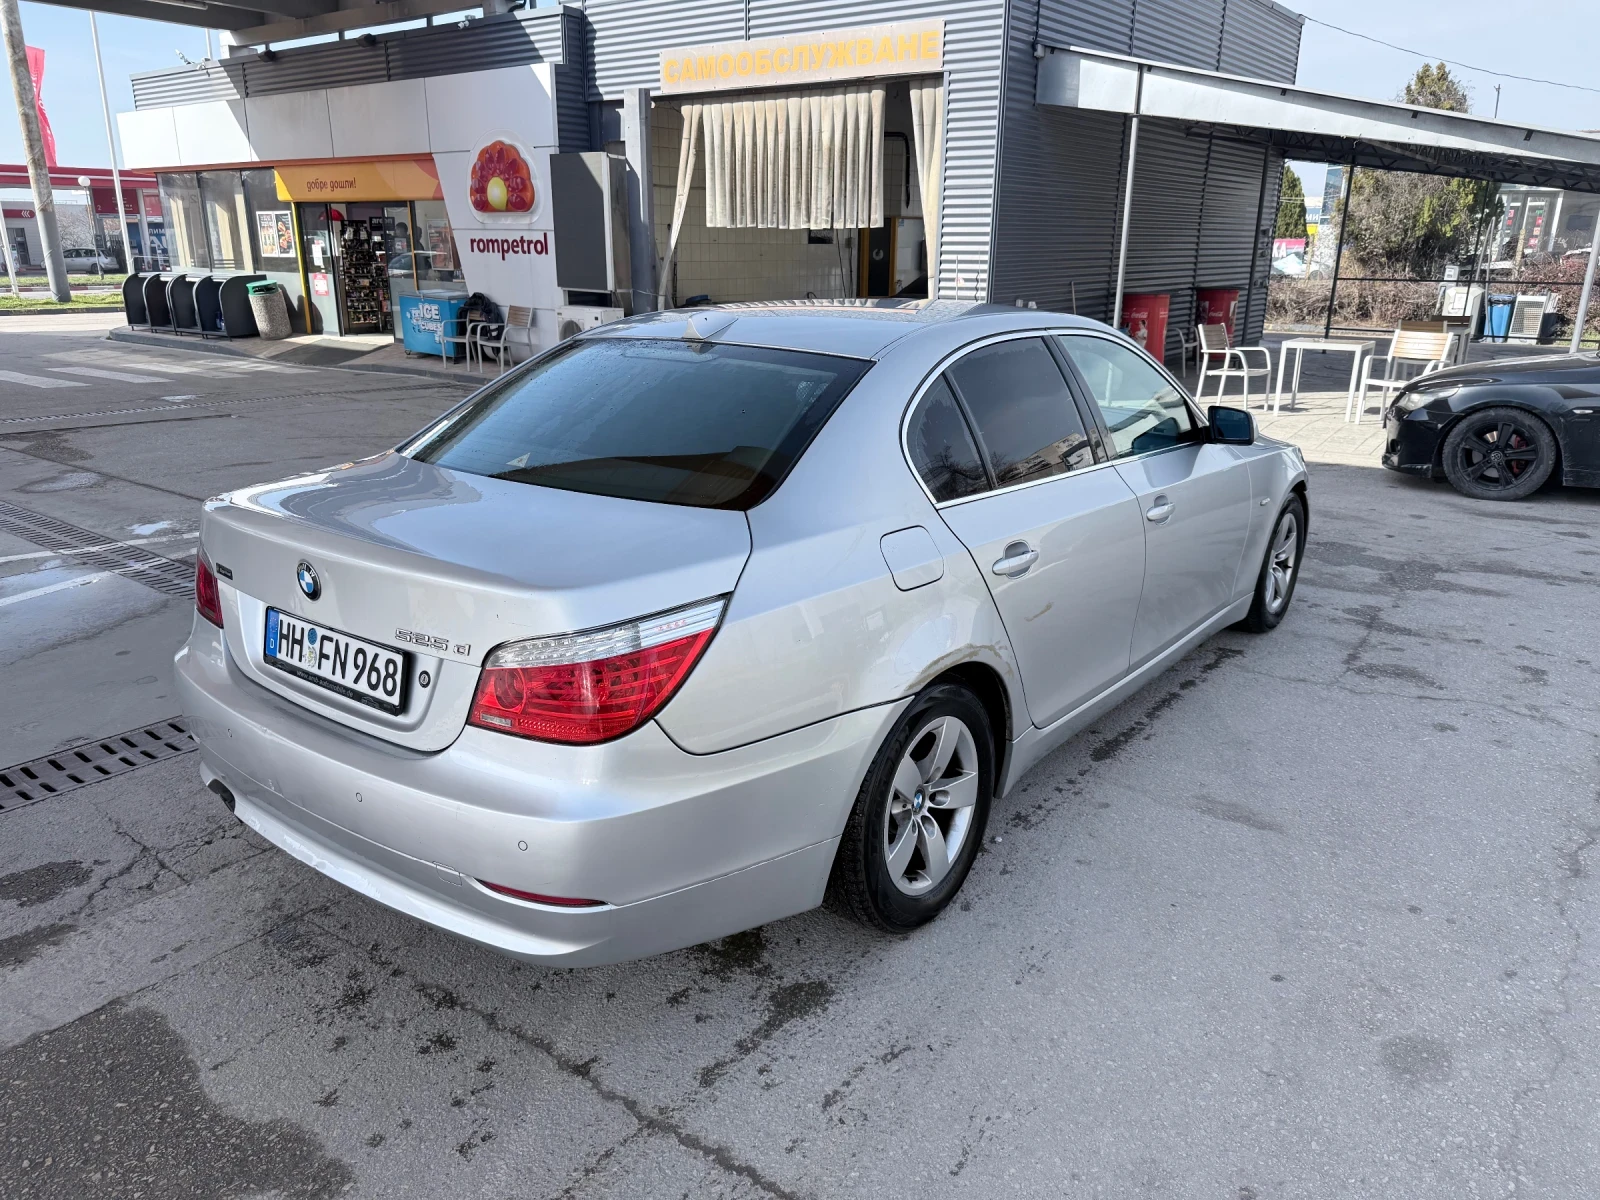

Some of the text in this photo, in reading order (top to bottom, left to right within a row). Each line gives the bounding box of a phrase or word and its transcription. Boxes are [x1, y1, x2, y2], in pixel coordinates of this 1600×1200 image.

[663, 31, 940, 84] САМООБСЛУЖВАНЕ
[307, 177, 357, 192] добре дошли!
[470, 232, 549, 261] rompetrol
[418, 303, 441, 321] ICE
[395, 628, 449, 651] 525
[278, 619, 398, 697] HH FN 968
